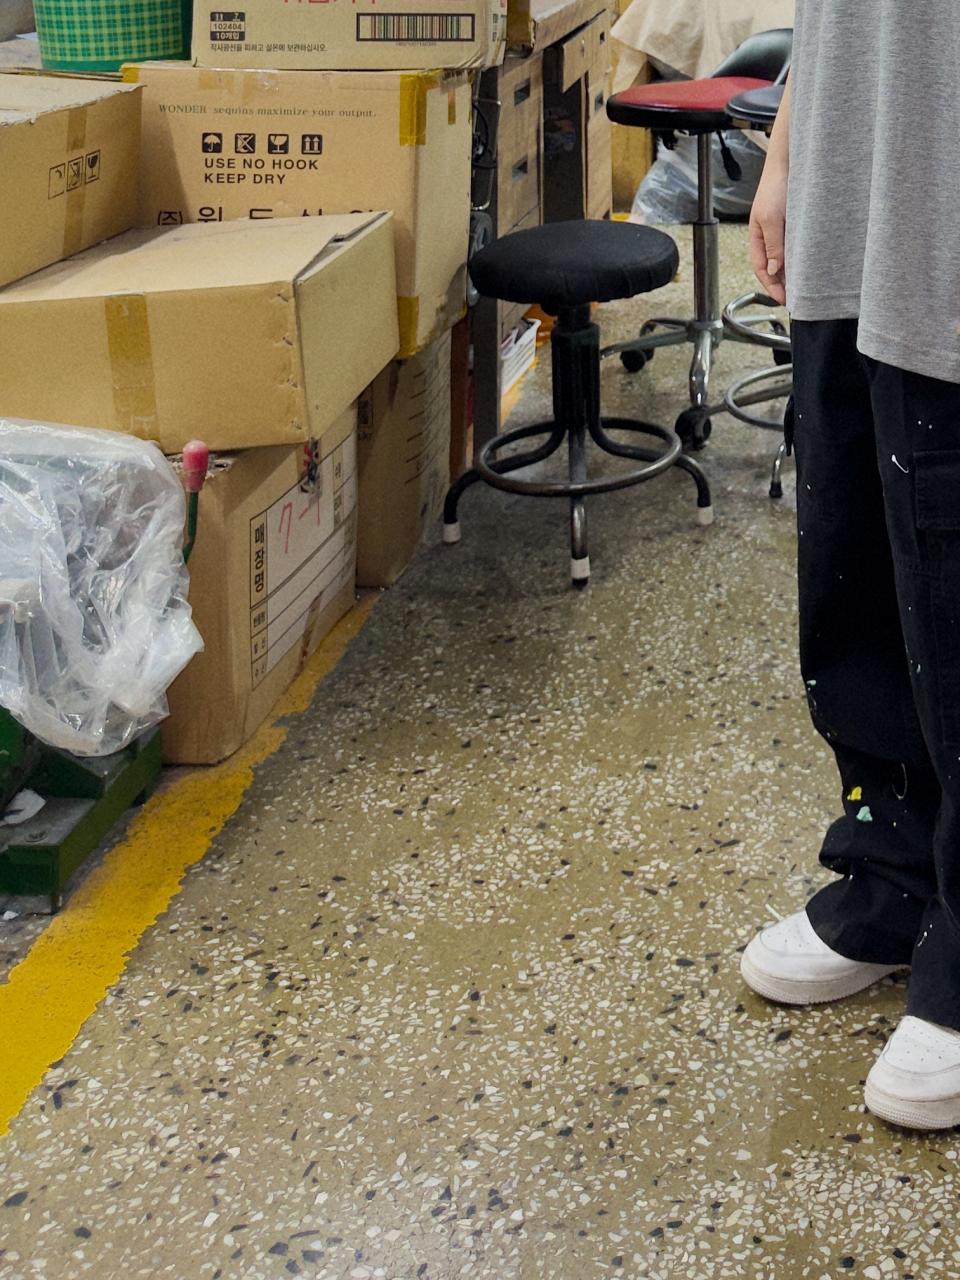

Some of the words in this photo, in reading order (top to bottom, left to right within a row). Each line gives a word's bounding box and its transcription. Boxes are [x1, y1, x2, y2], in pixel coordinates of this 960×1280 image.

[312, 108, 335, 119] your
[204, 158, 236, 169] USE
[242, 158, 265, 170] NO
[272, 158, 319, 170] HOOK
[204, 173, 247, 184] KEEP
[253, 173, 286, 185] DRY
